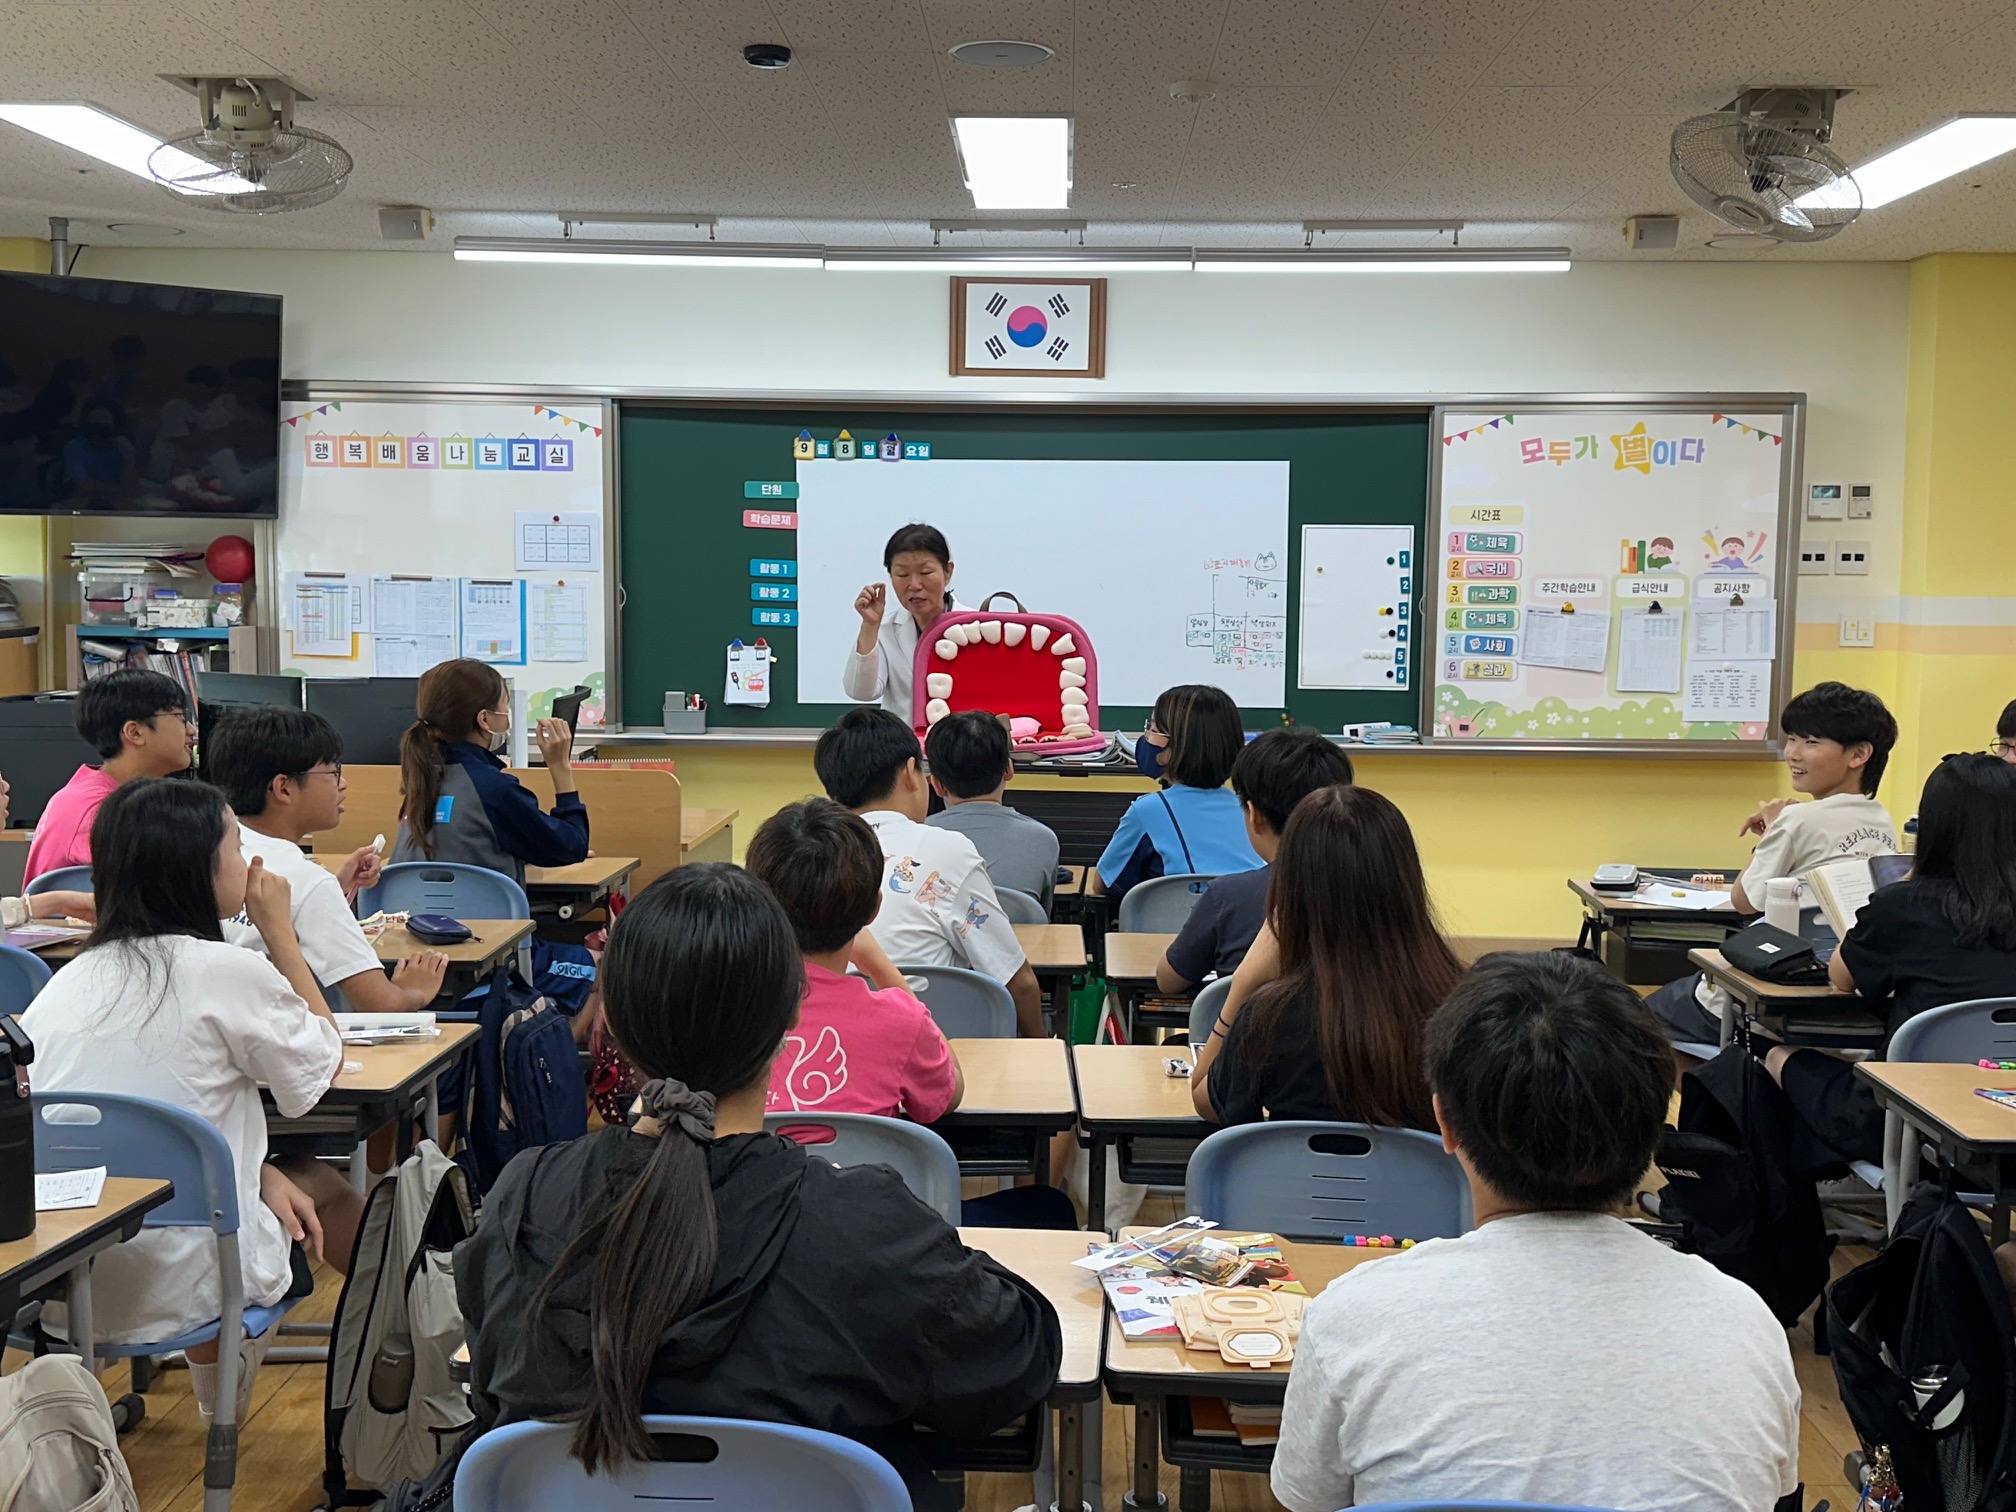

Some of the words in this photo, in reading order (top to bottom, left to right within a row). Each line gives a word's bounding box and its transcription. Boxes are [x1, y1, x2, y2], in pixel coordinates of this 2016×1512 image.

[800, 442, 808, 453] 9
[817, 443, 828, 455] 월
[841, 444, 850, 454] 8
[863, 444, 875, 456] 일
[905, 445, 929, 457] 요일
[1519, 435, 1599, 466] 모두가
[1621, 434, 1705, 466] 별이다
[761, 484, 783, 496] 단원
[750, 513, 792, 526] 학습문제
[1470, 509, 1502, 521] 시간표
[1454, 535, 1459, 545] 1
[1485, 536, 1508, 550] 체육
[1401, 555, 1407, 564] 1
[760, 563, 780, 574] 활동
[782, 564, 788, 574] 1
[1452, 561, 1460, 571] 2
[1485, 563, 1508, 576] 국어
[1402, 581, 1408, 590] 2
[1451, 586, 1459, 596] 3
[1541, 582, 1597, 594] 주간학습안내
[1631, 582, 1669, 594] 급식안내
[1713, 583, 1751, 595] 공지사항
[759, 587, 779, 598] 활동
[782, 588, 790, 599] 2
[1488, 588, 1511, 600] 과학
[1401, 606, 1407, 614] 3
[1450, 611, 1458, 621] 4
[760, 611, 780, 622] 활동
[783, 613, 791, 623] 3
[1485, 613, 1507, 625] 체육
[1399, 629, 1405, 637] 4
[1450, 637, 1457, 646] 5
[1484, 639, 1507, 652] 사회
[1397, 652, 1404, 660] 5
[1449, 662, 1456, 671] 6
[1483, 664, 1506, 676] 실과
[1398, 670, 1404, 679] 6
[1837, 827, 1880, 853] REPLACE
